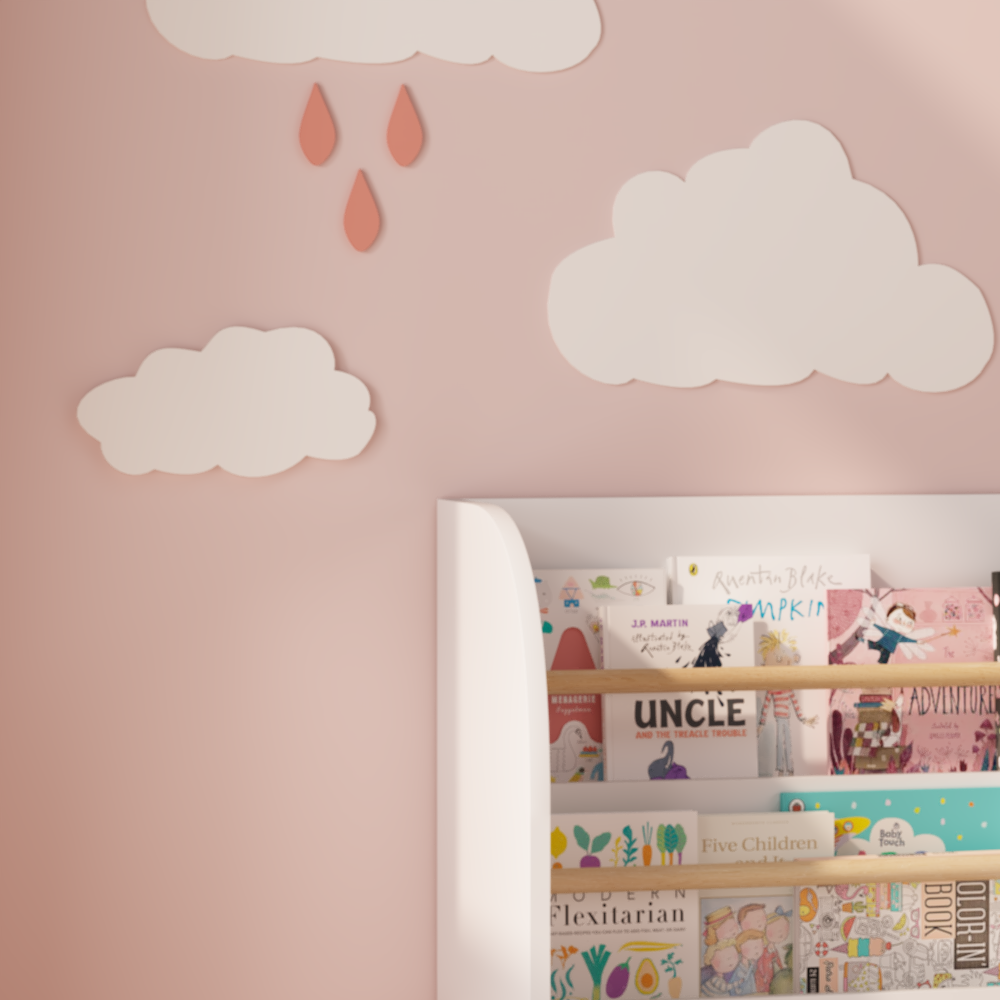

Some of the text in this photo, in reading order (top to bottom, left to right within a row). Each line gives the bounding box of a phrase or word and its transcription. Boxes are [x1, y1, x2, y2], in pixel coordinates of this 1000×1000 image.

[779, 565, 842, 593] Blake
[650, 619, 688, 628] MARTIN
[634, 698, 746, 729] UNCLE
[635, 729, 747, 740] AND THE TREACLE TROUBLE
[878, 837, 906, 848] Touch
[879, 829, 903, 839] Baby
[701, 835, 819, 853] Five Children
[550, 901, 686, 927] Flexitarian
[924, 883, 954, 937] BOOK
